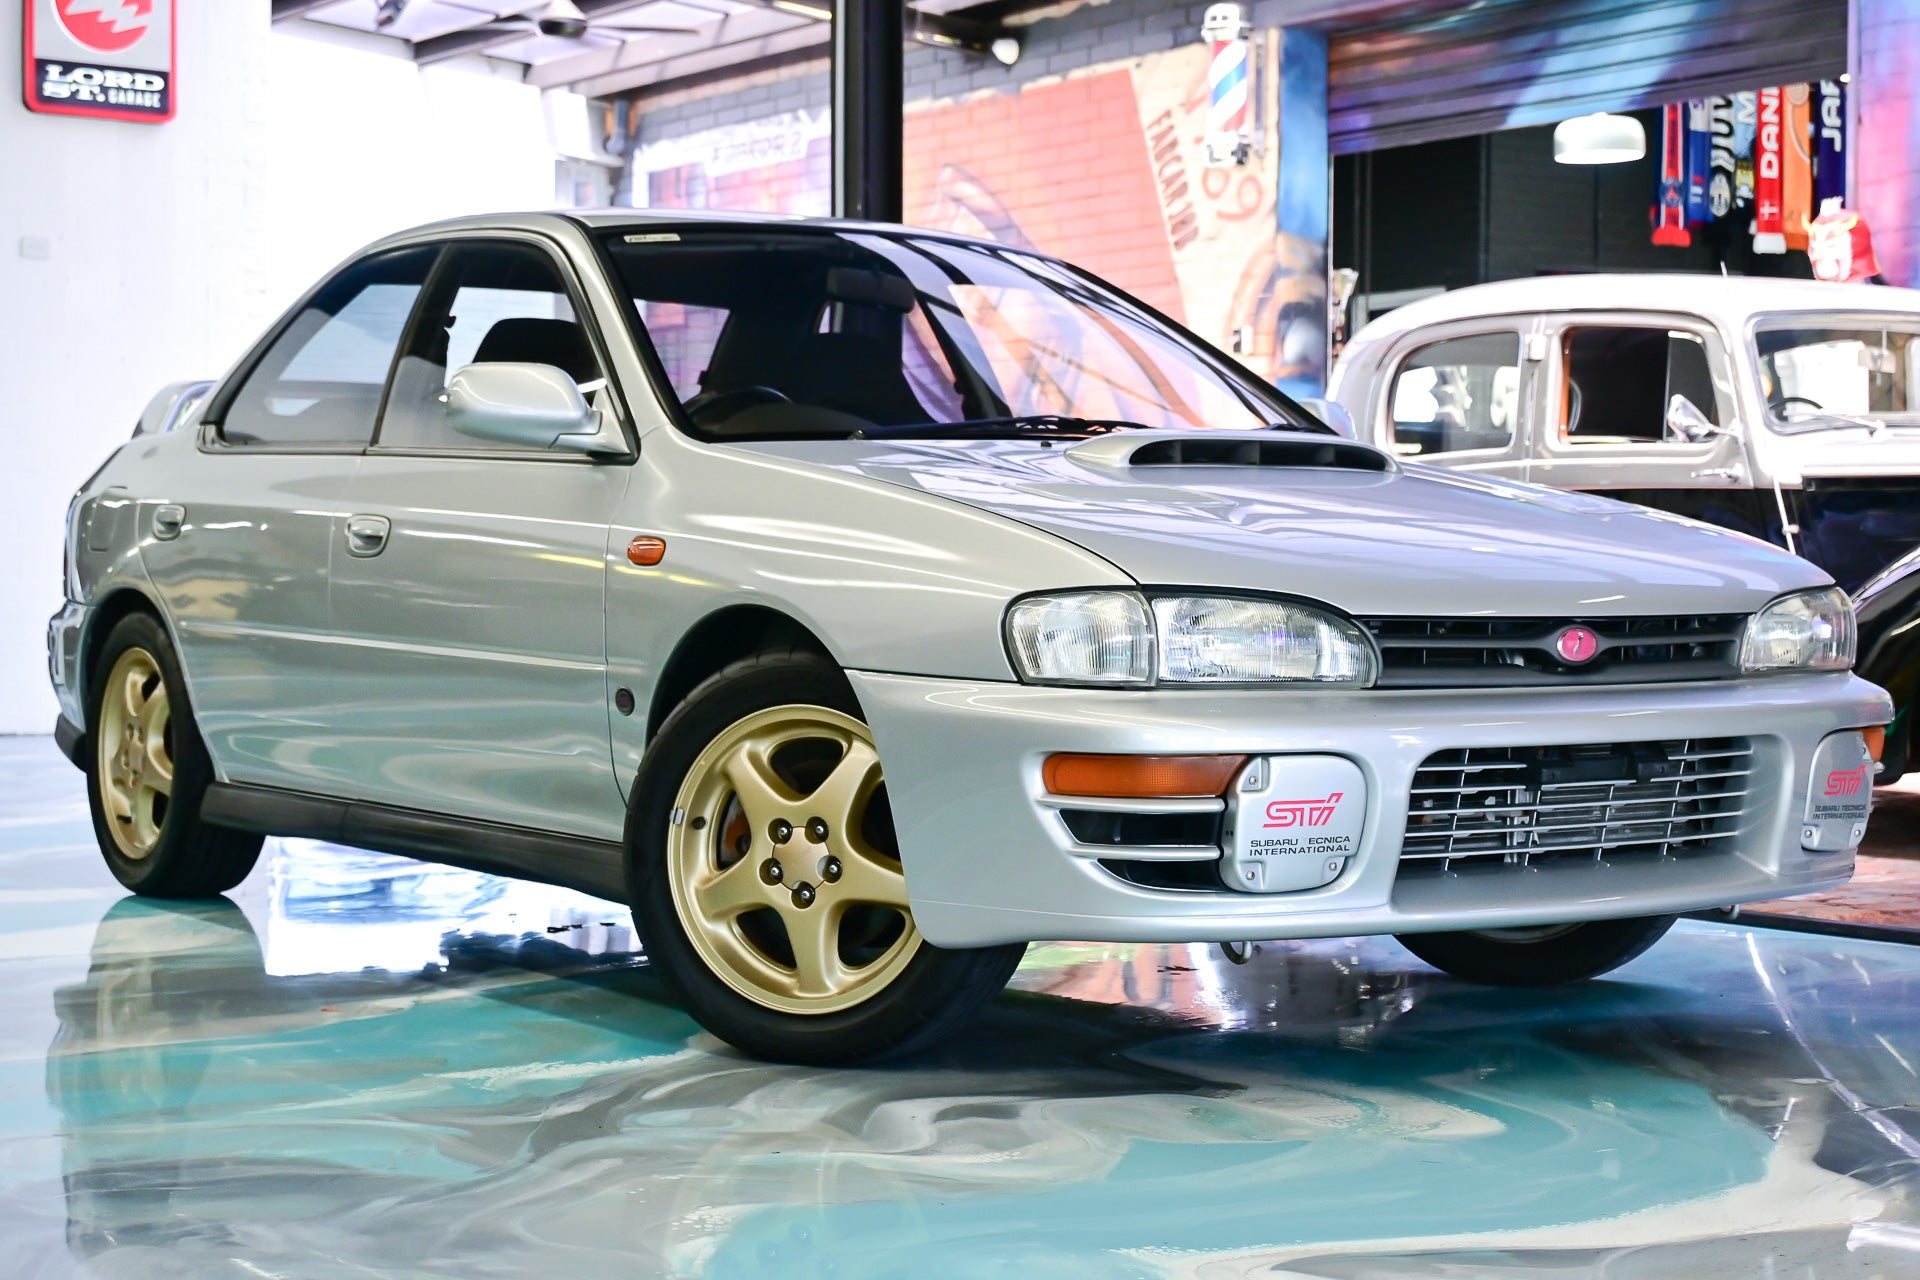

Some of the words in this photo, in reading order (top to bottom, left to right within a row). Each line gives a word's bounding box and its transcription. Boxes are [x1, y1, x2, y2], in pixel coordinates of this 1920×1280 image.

[44, 64, 165, 92] LORD
[1814, 804, 1841, 812] SUBARU
[1813, 812, 1865, 820] INTERNATIONAL
[1250, 838, 1298, 847] SUBARU
[1249, 845, 1350, 856] INTERNATIONAL
